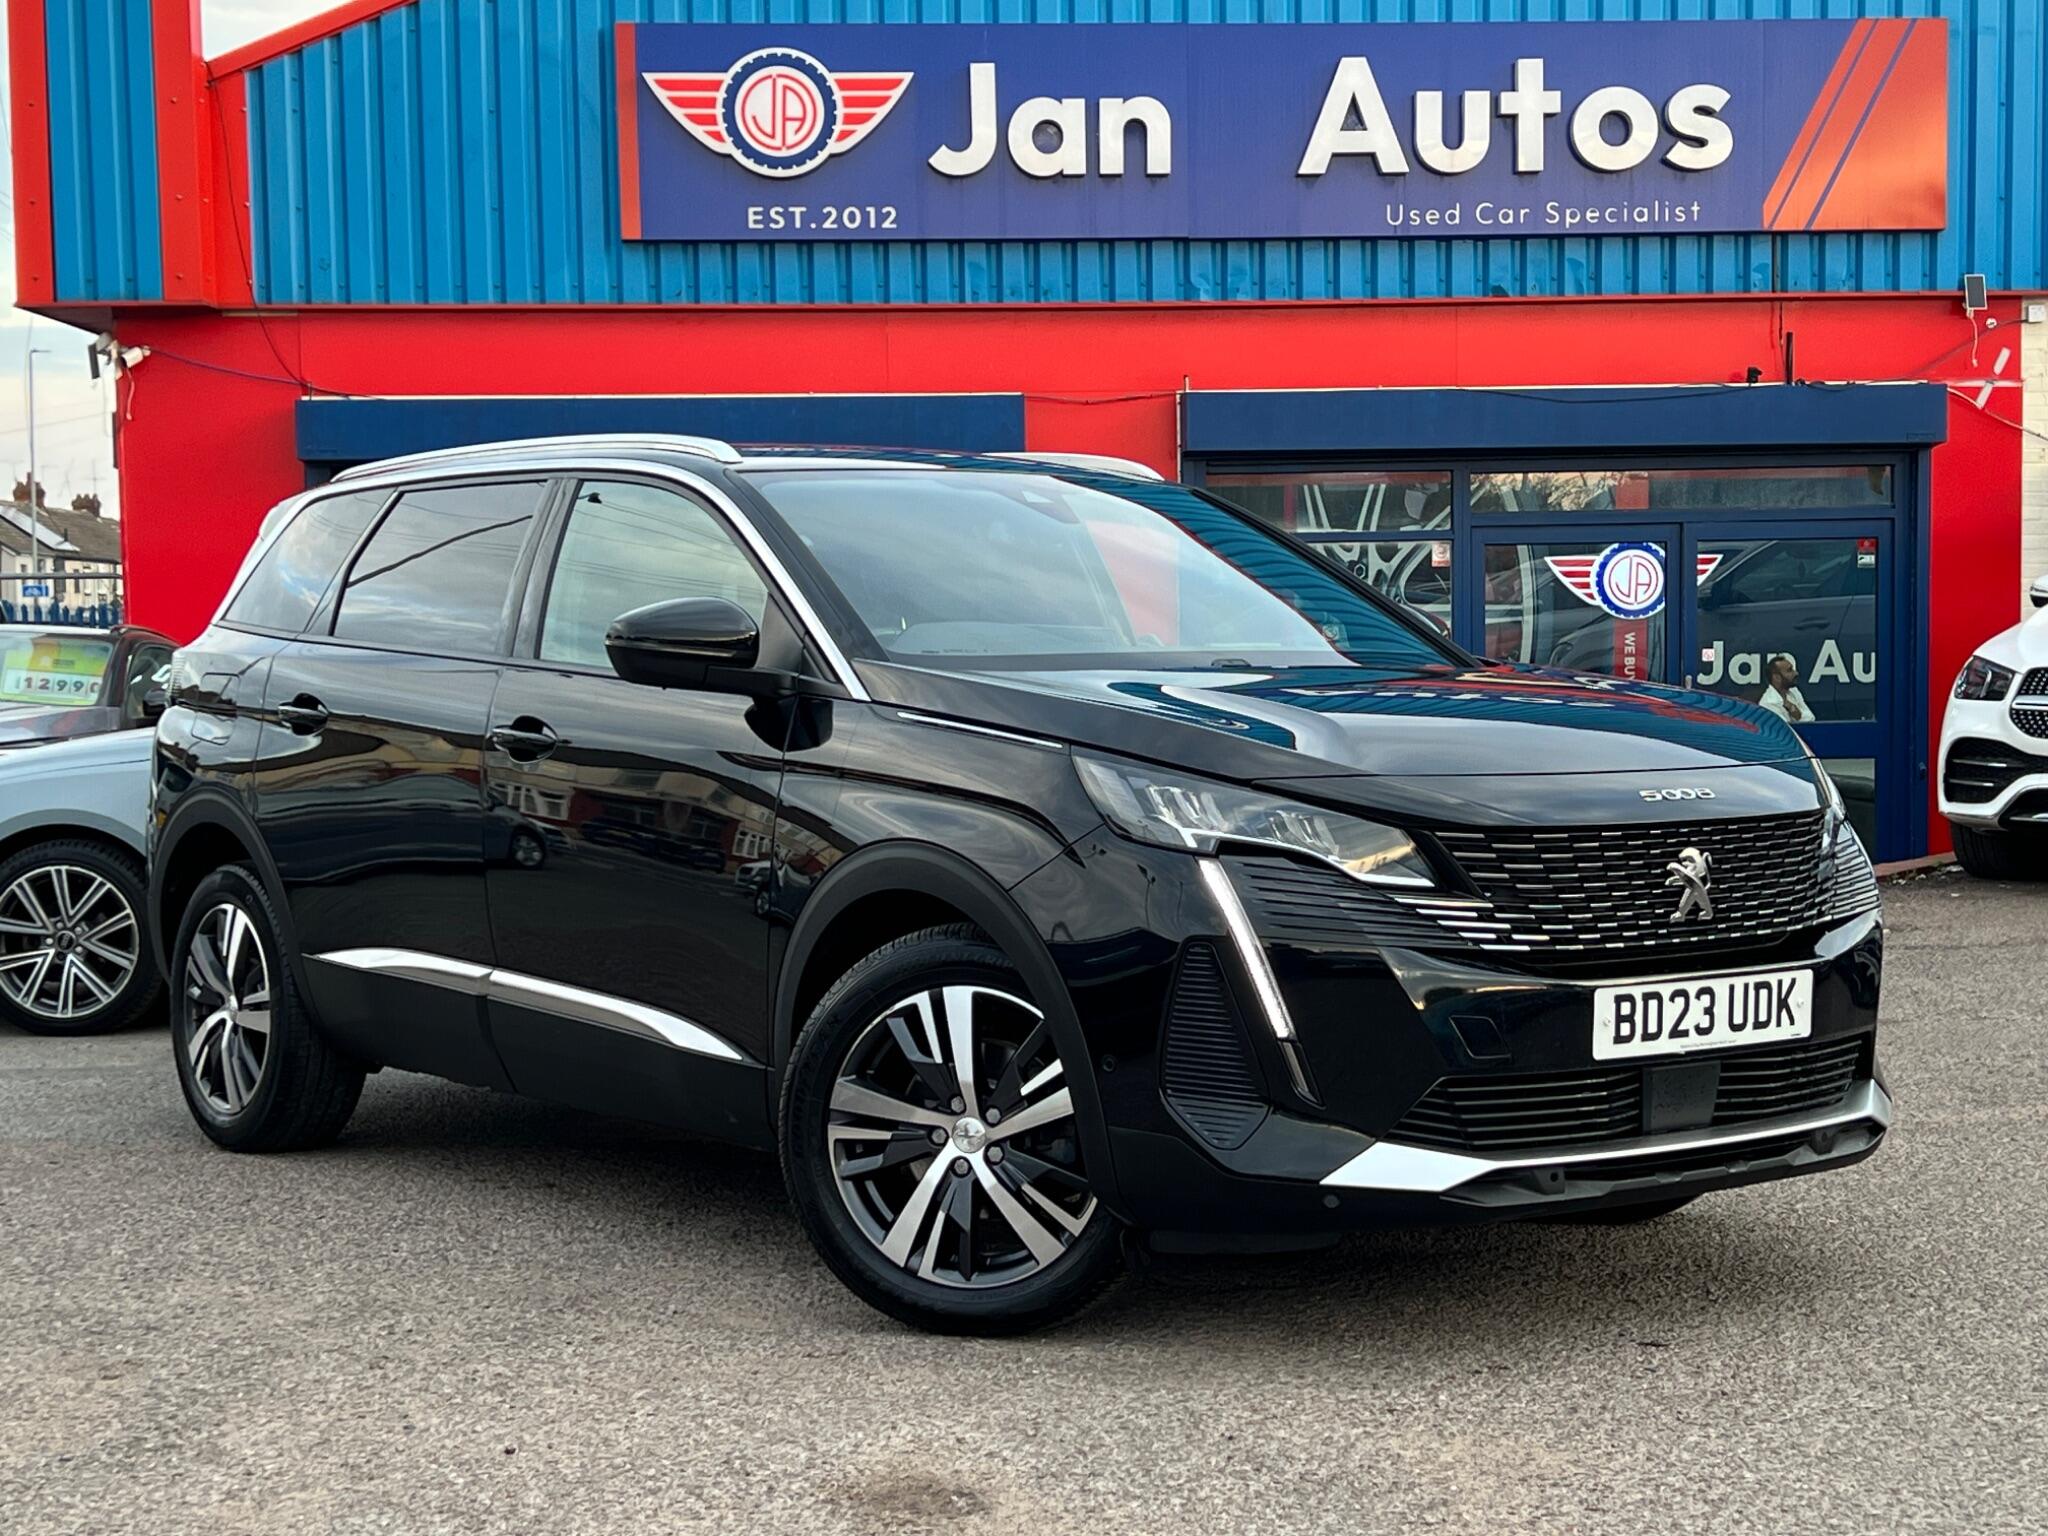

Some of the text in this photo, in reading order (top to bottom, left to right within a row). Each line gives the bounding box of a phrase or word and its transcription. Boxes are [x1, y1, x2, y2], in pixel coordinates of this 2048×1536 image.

[928, 56, 1734, 177] Jan Autos
[747, 206, 898, 230] EST.2012
[1385, 200, 1701, 228] Used Car Specialist
[1624, 632, 1636, 654] WE
[1613, 977, 1797, 1045] BD23 UDK
